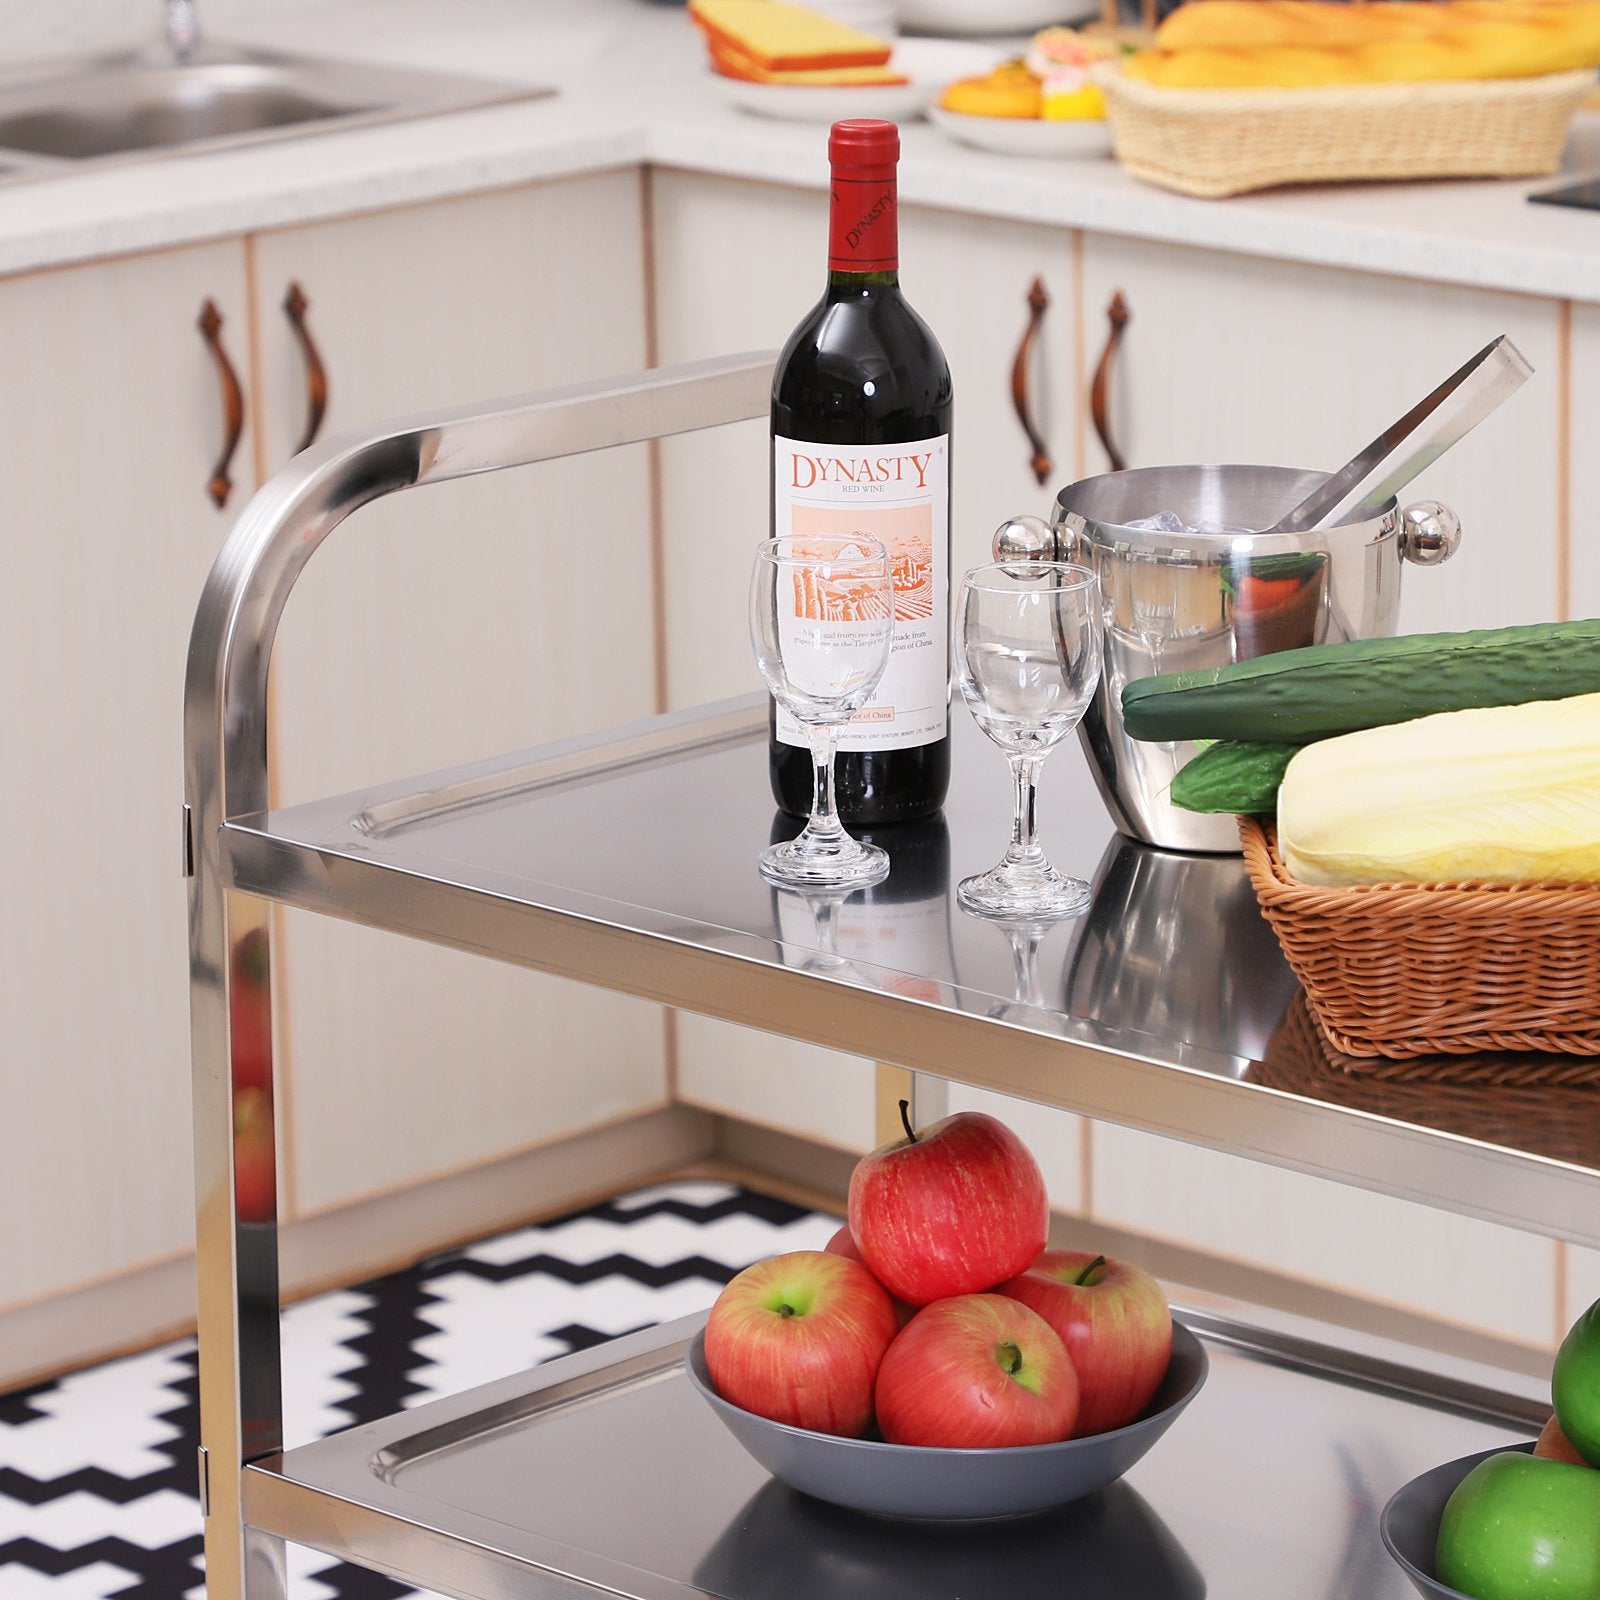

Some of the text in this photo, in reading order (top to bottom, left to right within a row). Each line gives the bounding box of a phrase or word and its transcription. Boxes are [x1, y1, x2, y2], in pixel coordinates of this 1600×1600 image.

[845, 188, 893, 249] DYNASTY
[790, 452, 933, 488] DYNASTY
[842, 485, 885, 493] RED WINE
[893, 633, 911, 642] made
[912, 631, 927, 639] from
[907, 643, 914, 652] of
[872, 711, 892, 719] China
